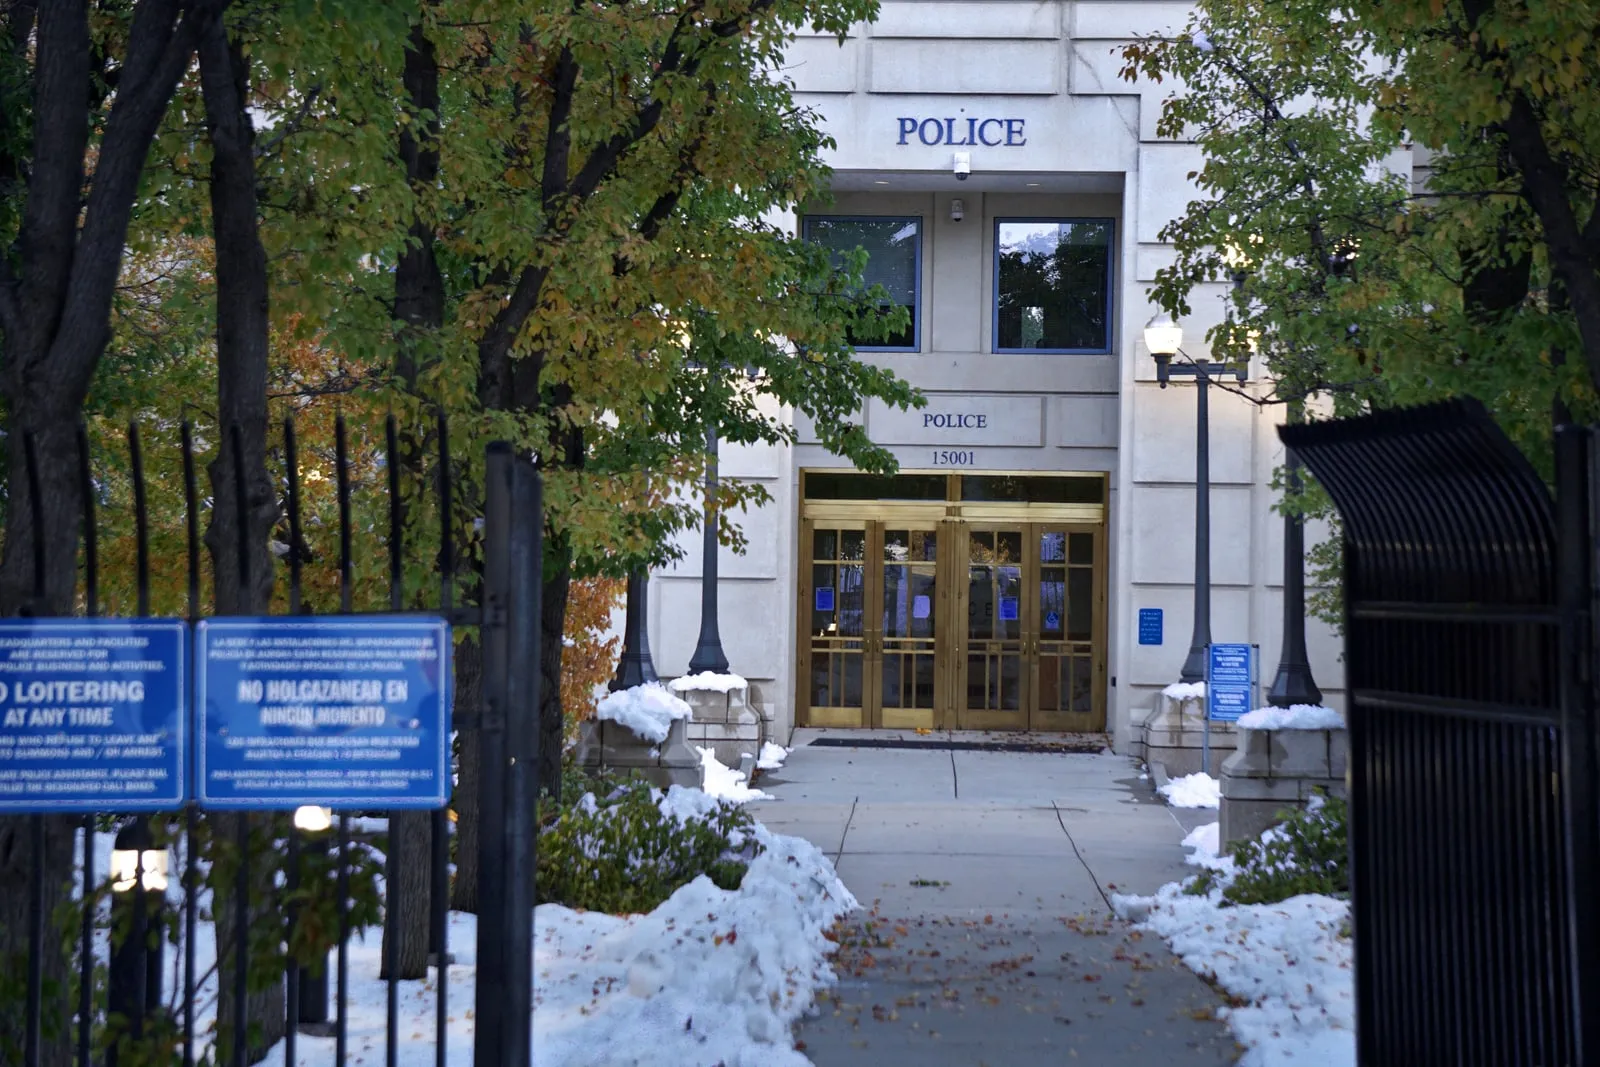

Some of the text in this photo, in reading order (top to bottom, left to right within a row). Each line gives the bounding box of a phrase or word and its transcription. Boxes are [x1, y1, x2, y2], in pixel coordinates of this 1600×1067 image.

[896, 117, 1027, 146] POLICE
[923, 413, 987, 429] POLICE
[932, 451, 975, 466] 15001
[14, 680, 145, 703] LOITERING
[237, 679, 264, 703] NO
[385, 679, 409, 703] EN
[4, 707, 114, 727] AT ANY TIME
